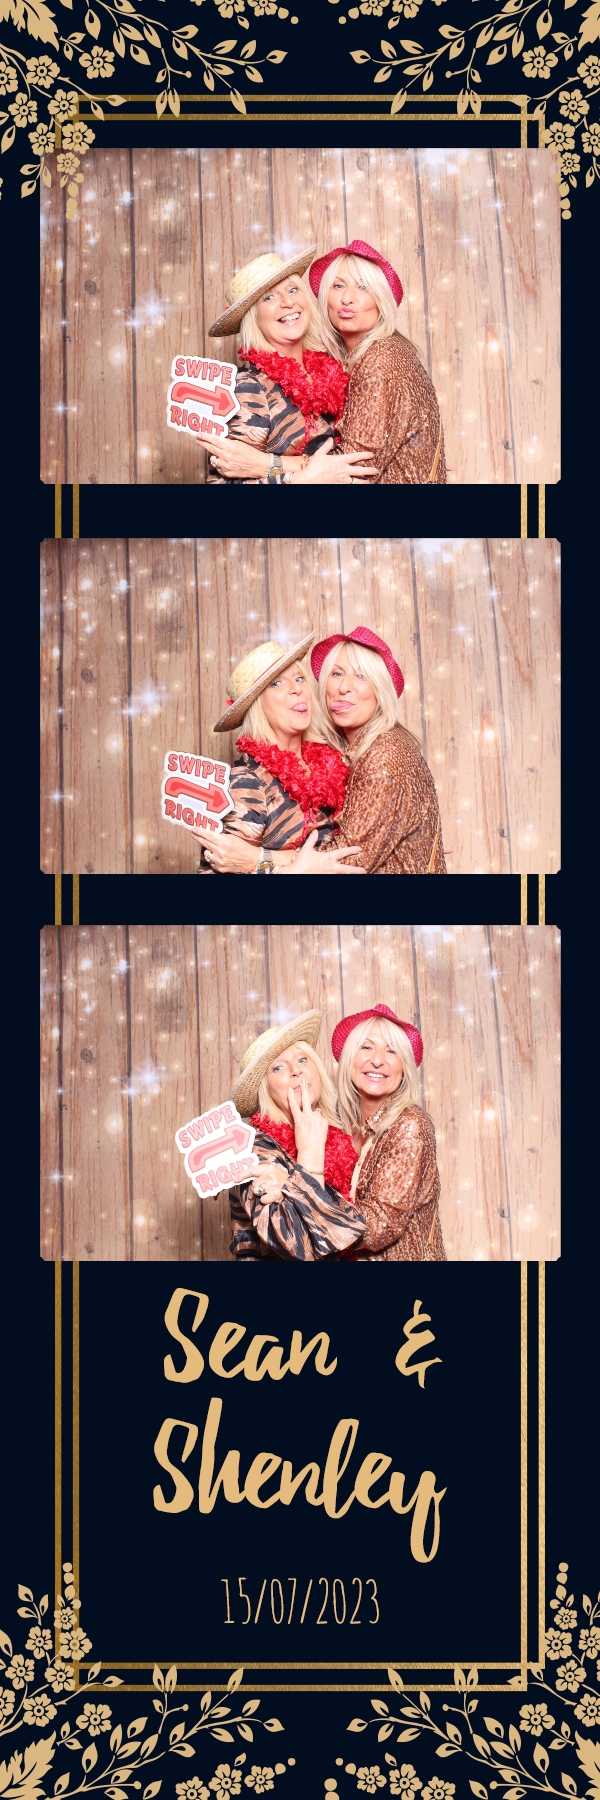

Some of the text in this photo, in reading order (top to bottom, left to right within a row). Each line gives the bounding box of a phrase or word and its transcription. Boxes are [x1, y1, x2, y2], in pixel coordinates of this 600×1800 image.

[175, 358, 233, 386] SWIPE
[170, 405, 224, 436] RIGHT
[168, 754, 226, 785] SWIPE
[164, 799, 219, 832] RIGHT
[178, 1104, 236, 1148] SWIPE
